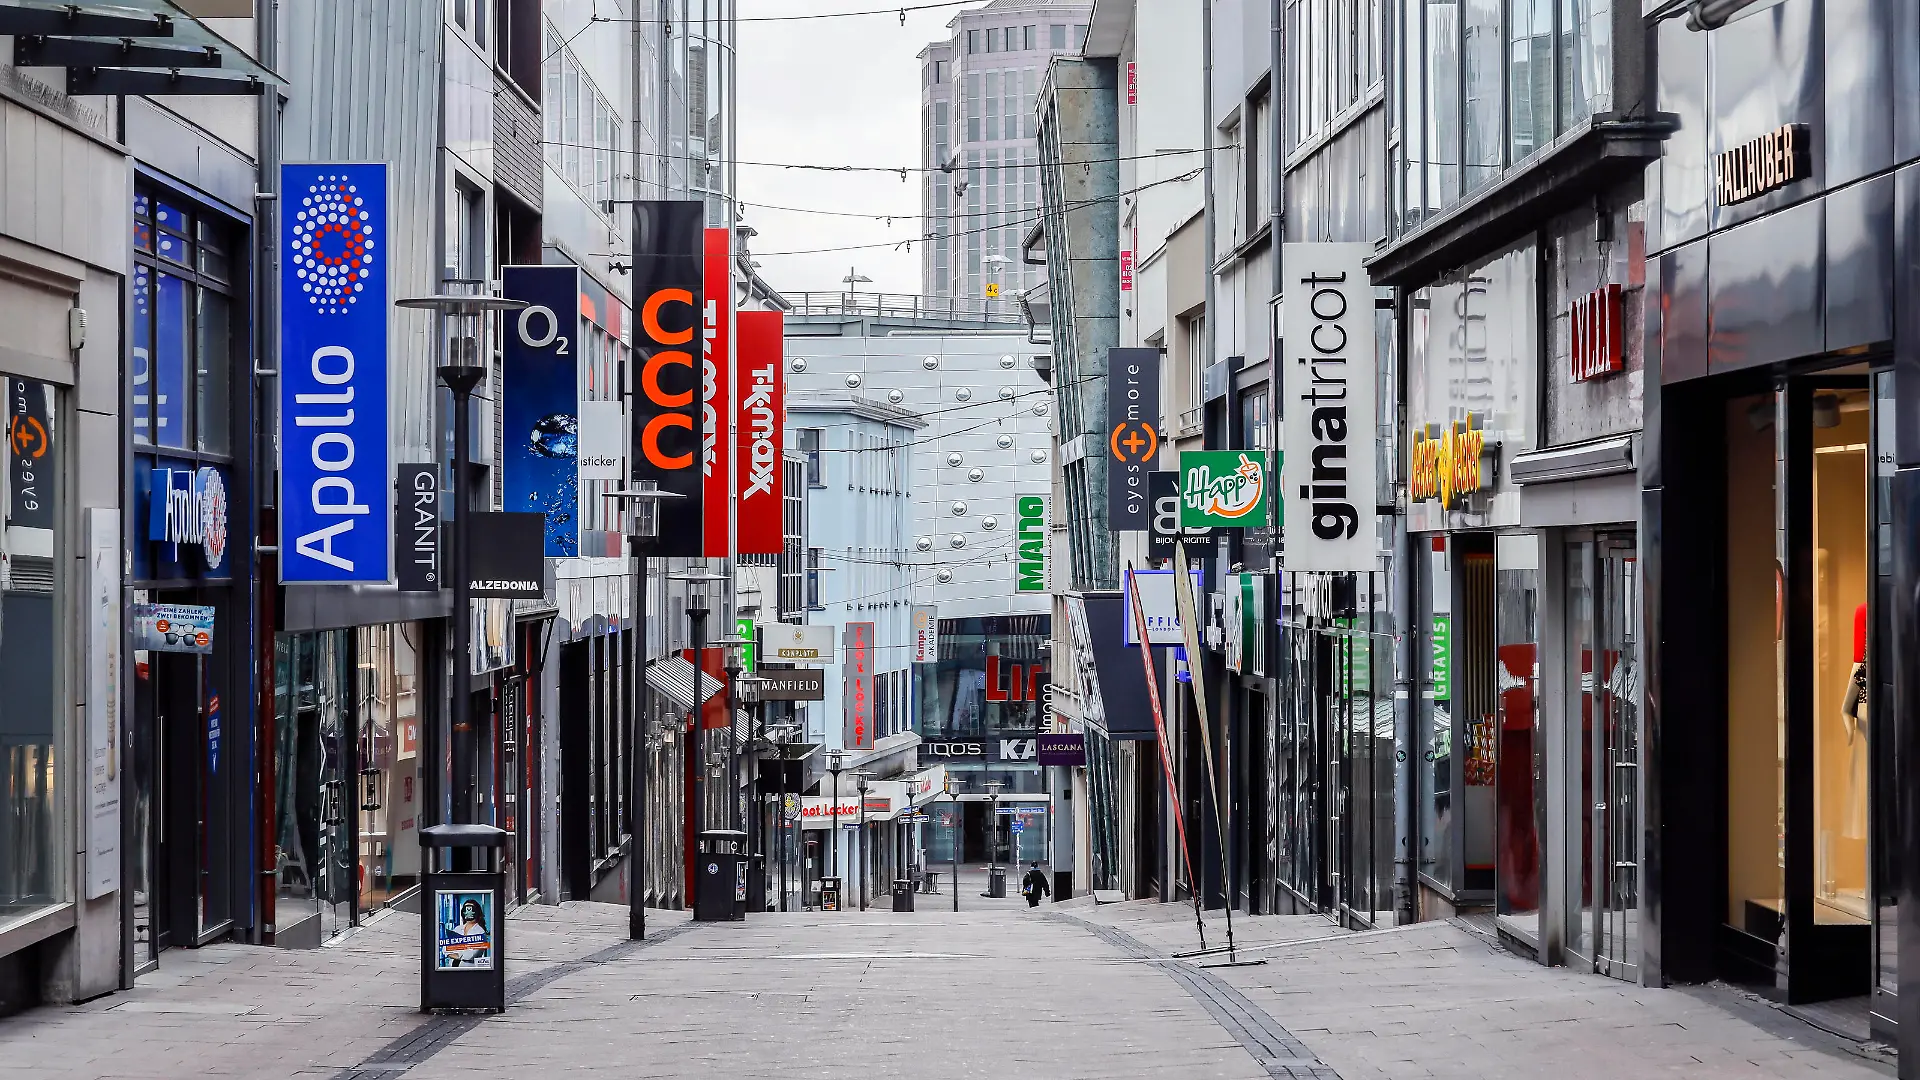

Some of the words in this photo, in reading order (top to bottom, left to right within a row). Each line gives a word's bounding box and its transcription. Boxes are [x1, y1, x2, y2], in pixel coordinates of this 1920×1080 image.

[1715, 123, 1794, 207] HALLHUBER
[641, 288, 693, 470] CCC
[1127, 364, 1140, 421] more
[1299, 271, 1359, 540] ginatricot
[295, 344, 370, 572] Apollo
[580, 454, 617, 467] sticker
[1127, 464, 1143, 514] eyes
[165, 468, 203, 562] Apollo
[469, 580, 539, 591] ALZEDONIA
[1148, 616, 1181, 627] FFIC
[915, 629, 925, 661] Kamps
[1432, 622, 1446, 697] GRAVIS
[761, 680, 819, 691] MANFIELD
[928, 743, 982, 757] IQOS
[1041, 743, 1083, 751] LASCANA
[802, 804, 821, 817] oot
[823, 803, 859, 816] Locker
[450, 935, 484, 944] EXPERTIN.
